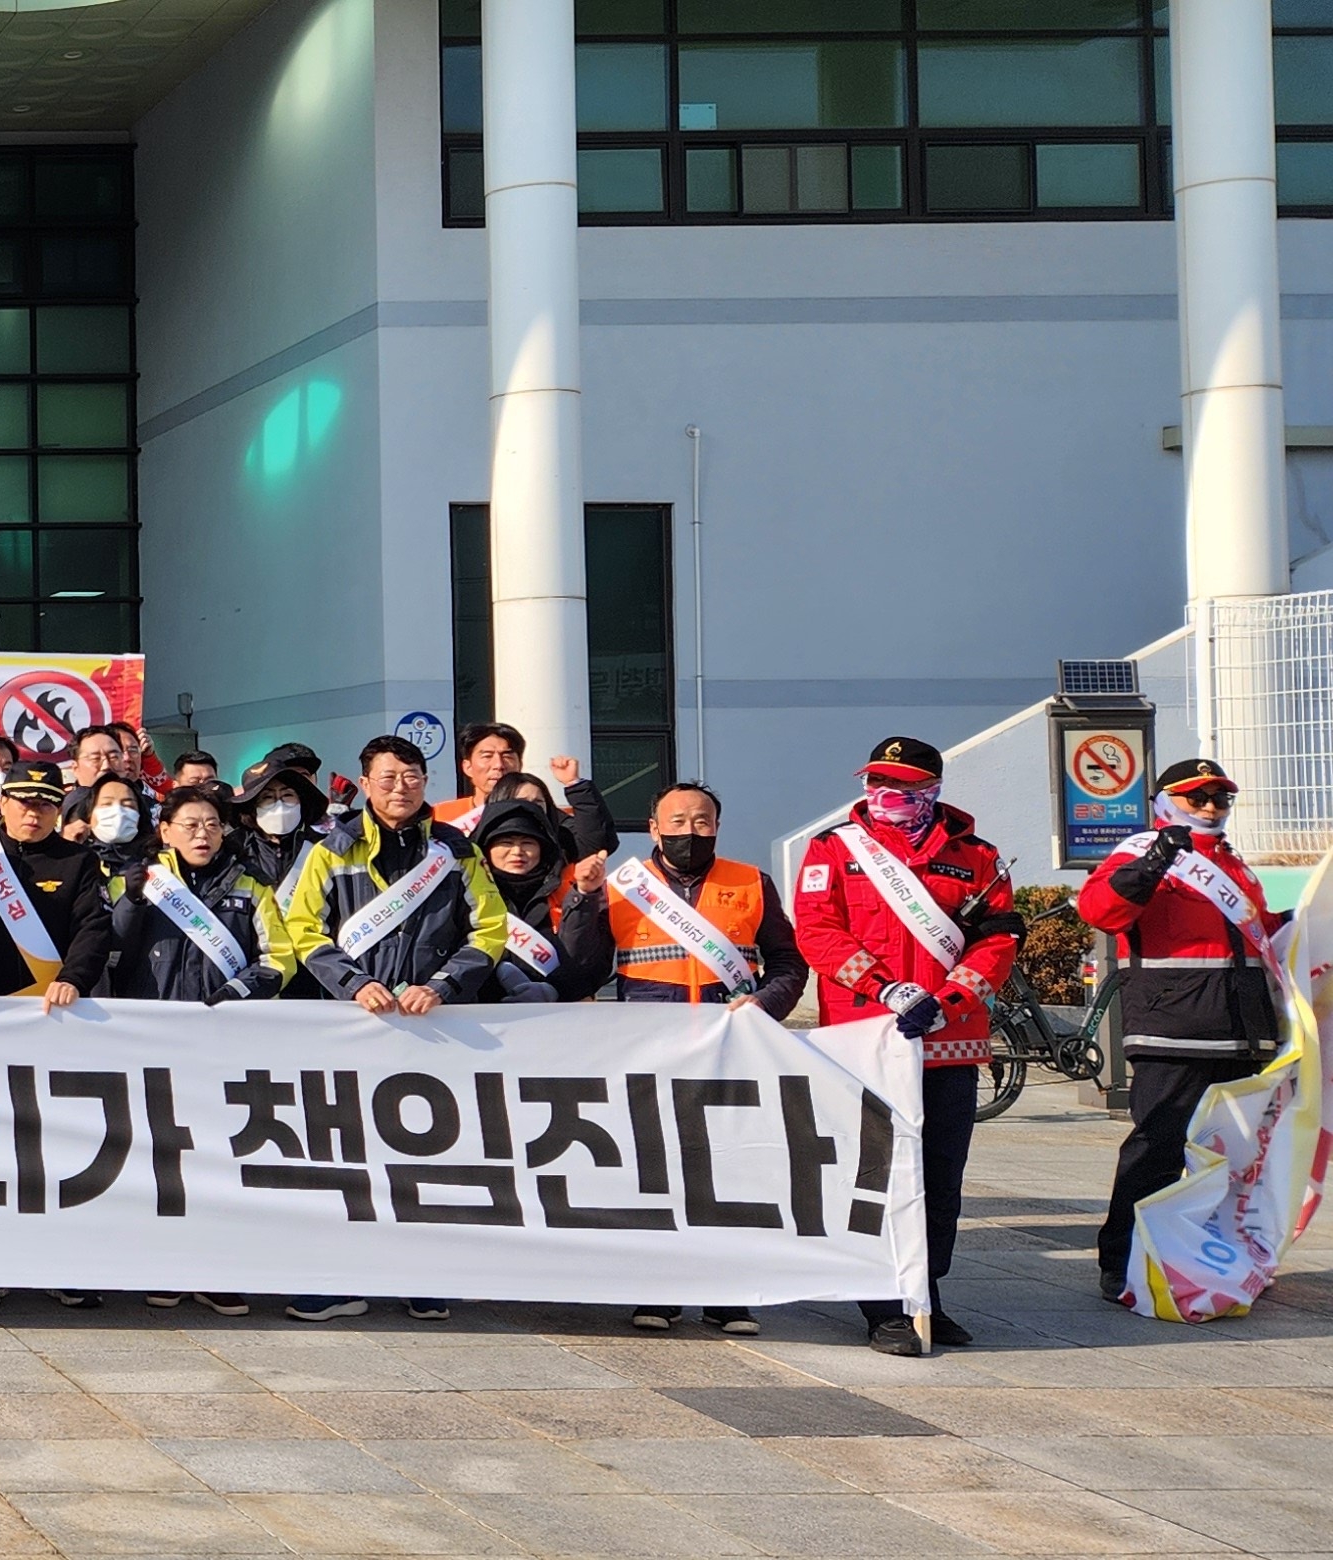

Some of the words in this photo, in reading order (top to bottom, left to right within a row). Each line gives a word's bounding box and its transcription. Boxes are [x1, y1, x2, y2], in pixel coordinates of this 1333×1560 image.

[408, 731, 433, 745] 175
[1074, 803, 1138, 820] 금연구역
[224, 1068, 896, 1238] 책임진다!
